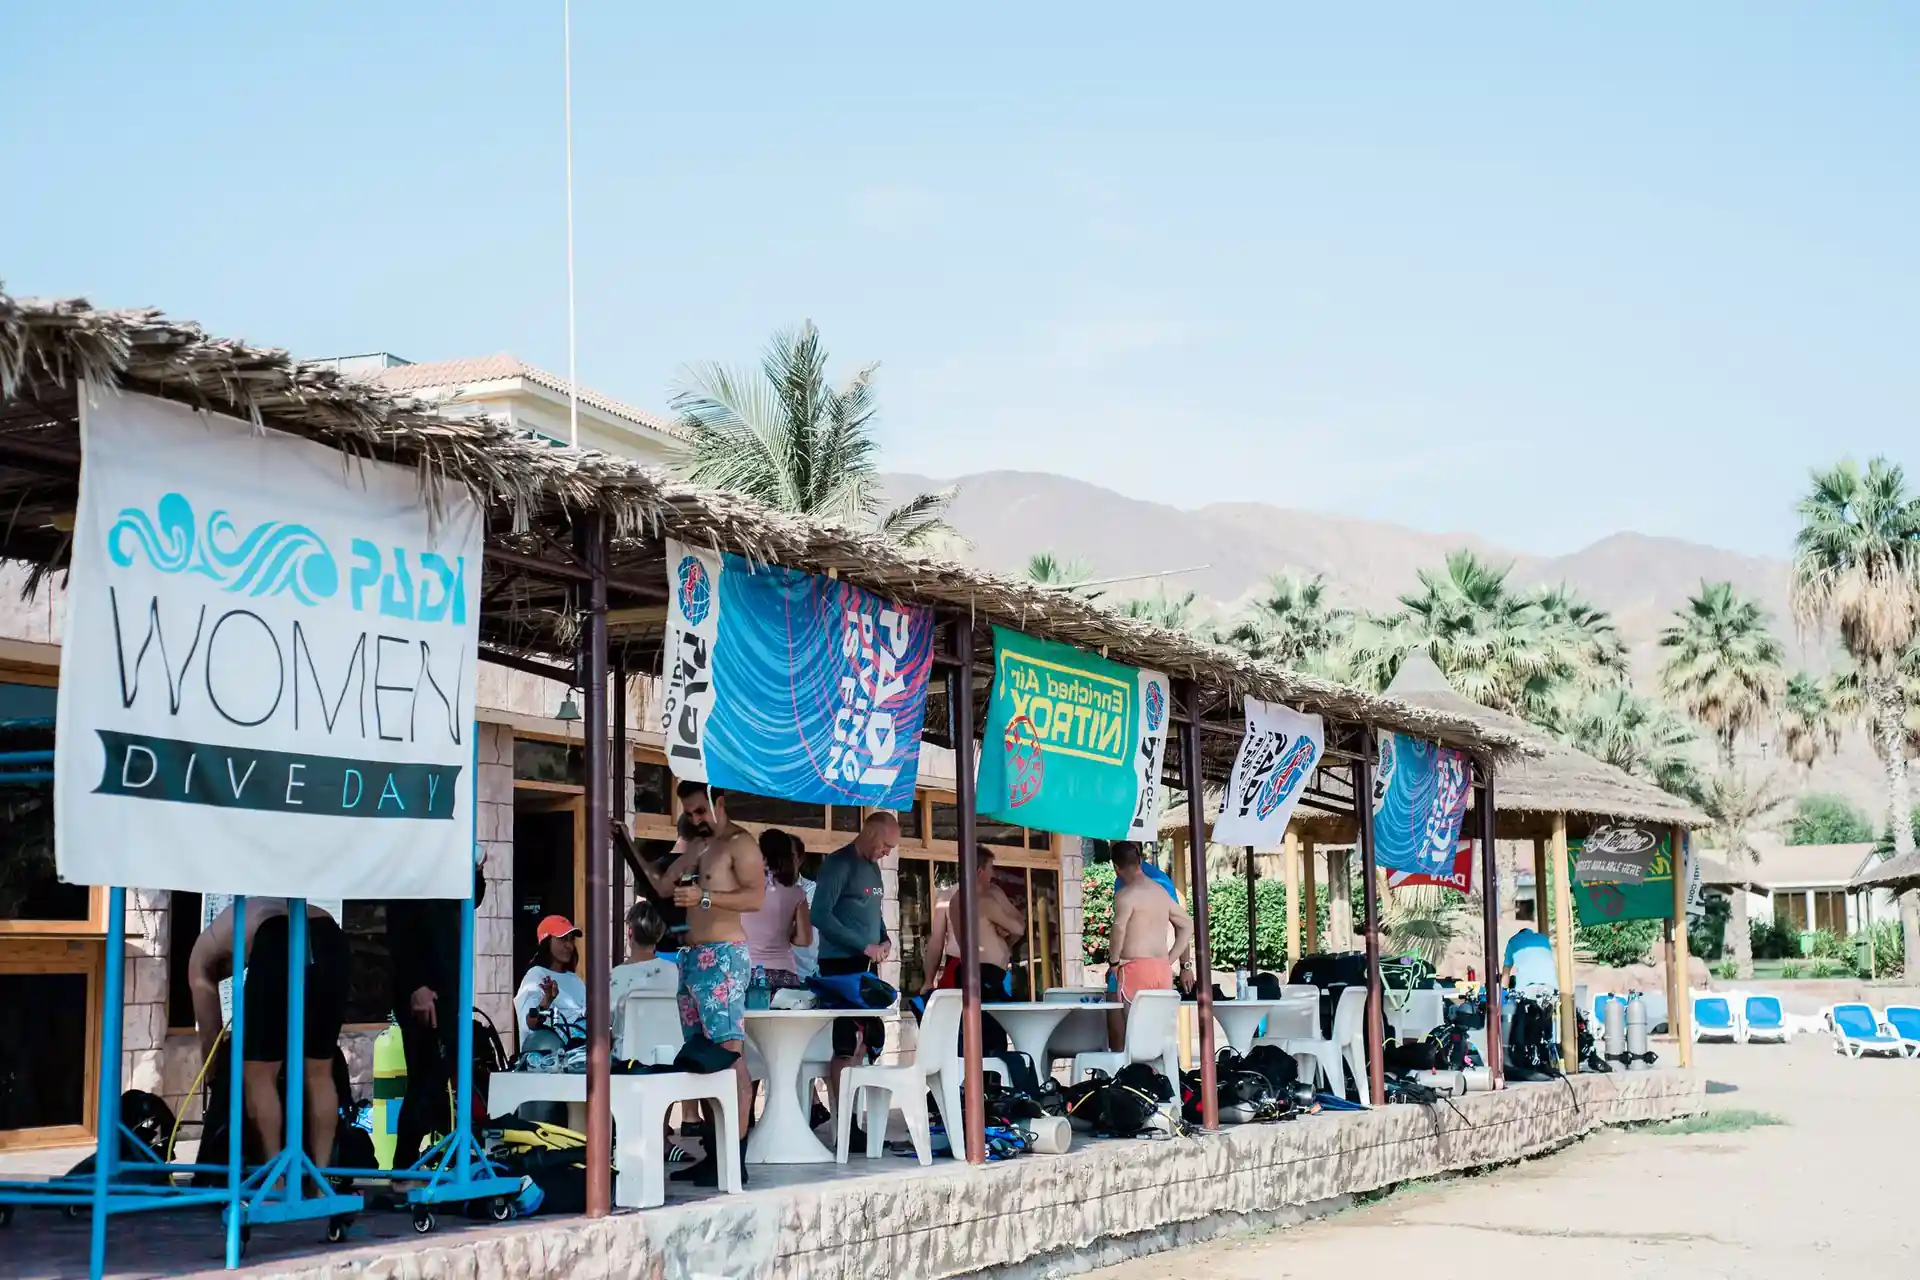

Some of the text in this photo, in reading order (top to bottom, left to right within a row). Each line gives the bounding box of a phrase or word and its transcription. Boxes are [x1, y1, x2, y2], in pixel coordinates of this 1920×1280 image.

[351, 537, 467, 626] PADI
[110, 586, 465, 746] WOMEN
[670, 631, 709, 761] PADI
[843, 613, 874, 783] DIVING
[859, 609, 909, 786] PADI
[122, 744, 441, 812] DIVE DAY
[1622, 862, 1643, 878] HERE
